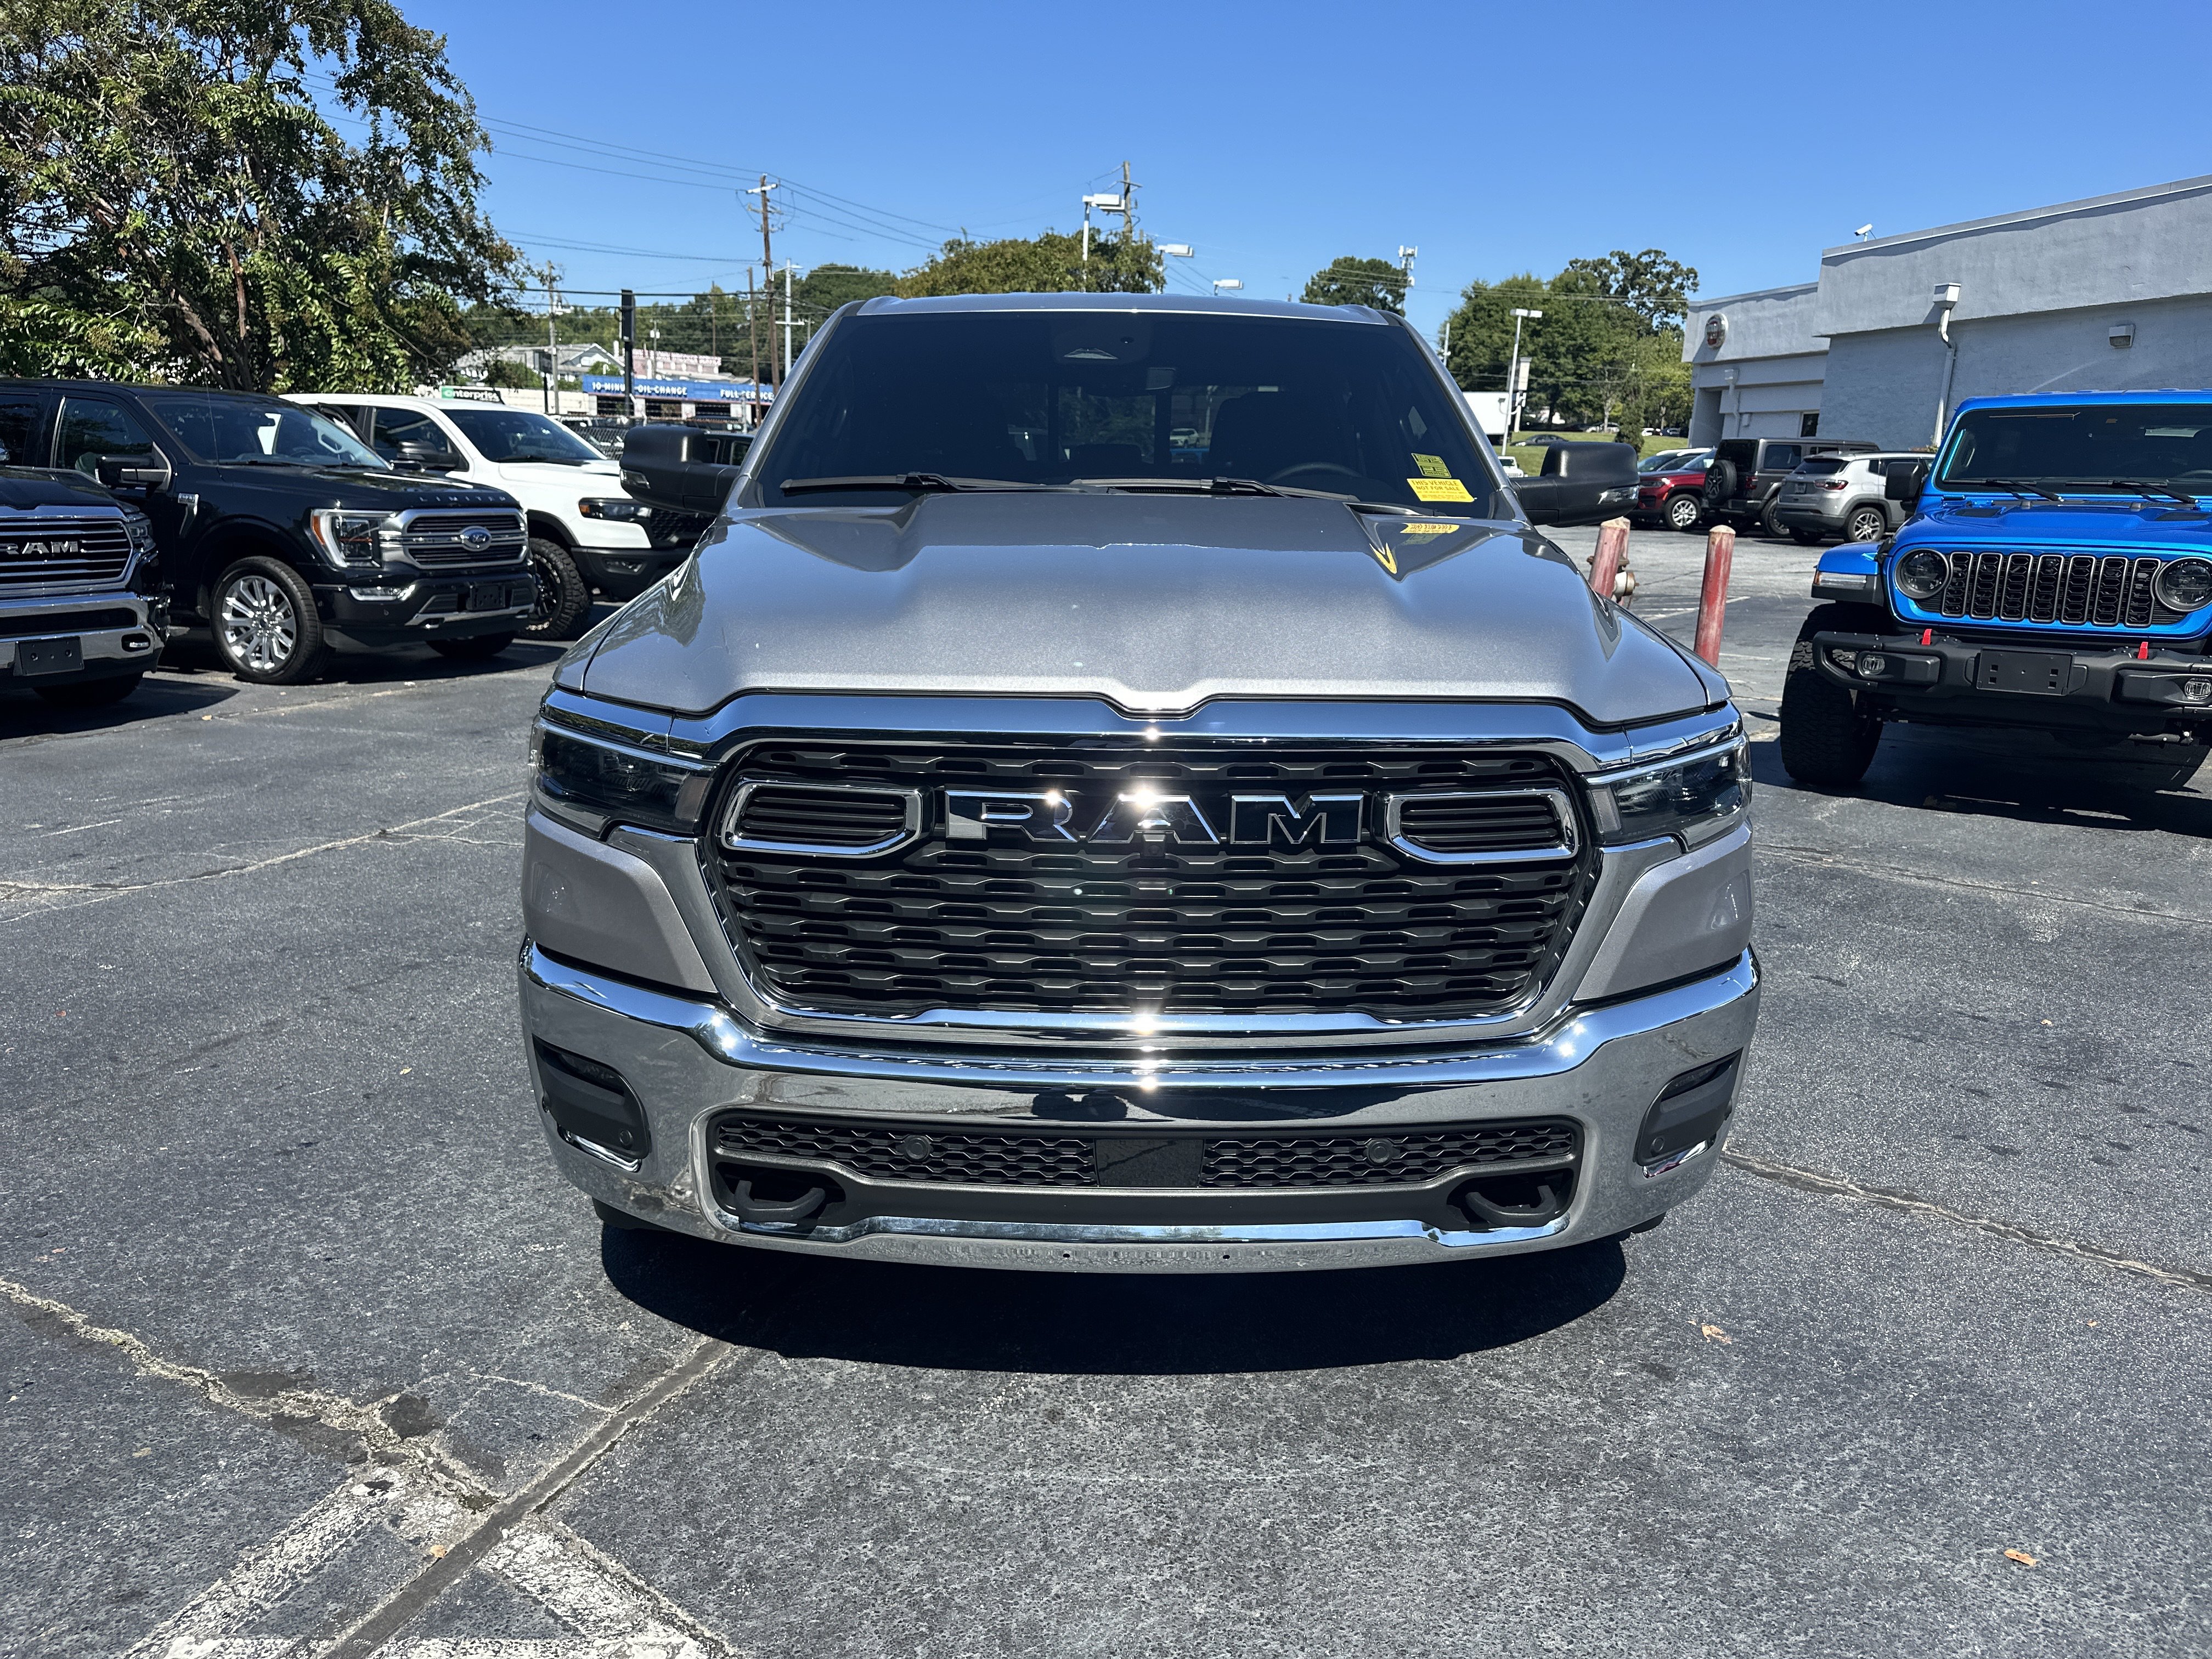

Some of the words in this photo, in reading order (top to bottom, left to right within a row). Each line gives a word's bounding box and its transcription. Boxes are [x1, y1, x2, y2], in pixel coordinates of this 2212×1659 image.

[741, 390, 774, 400] ERICE
[0, 541, 78, 555] RAM
[944, 789, 1365, 845] RAM
